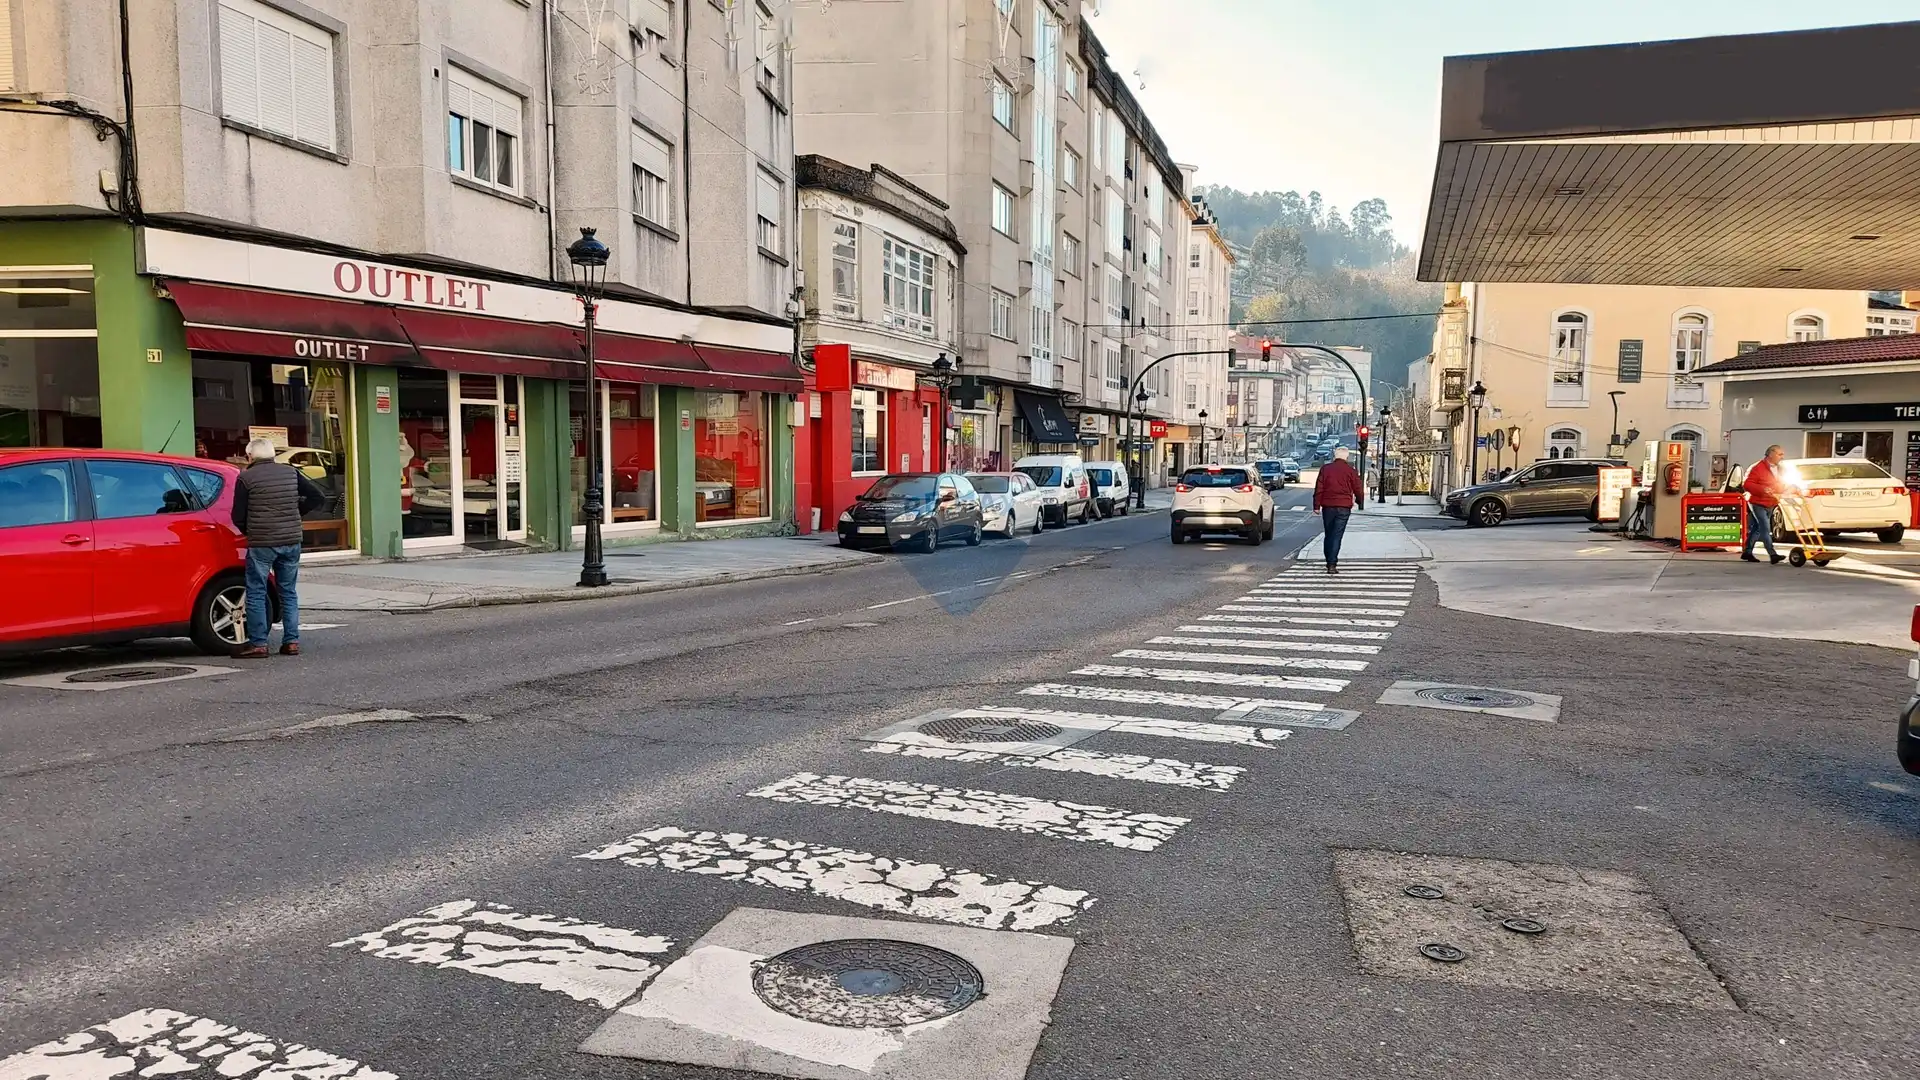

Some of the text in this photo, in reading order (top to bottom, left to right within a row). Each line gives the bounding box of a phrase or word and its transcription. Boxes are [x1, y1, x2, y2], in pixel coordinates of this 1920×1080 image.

[333, 261, 491, 311] OUTLET
[148, 350, 161, 362] 51
[294, 339, 370, 361] OUTLET
